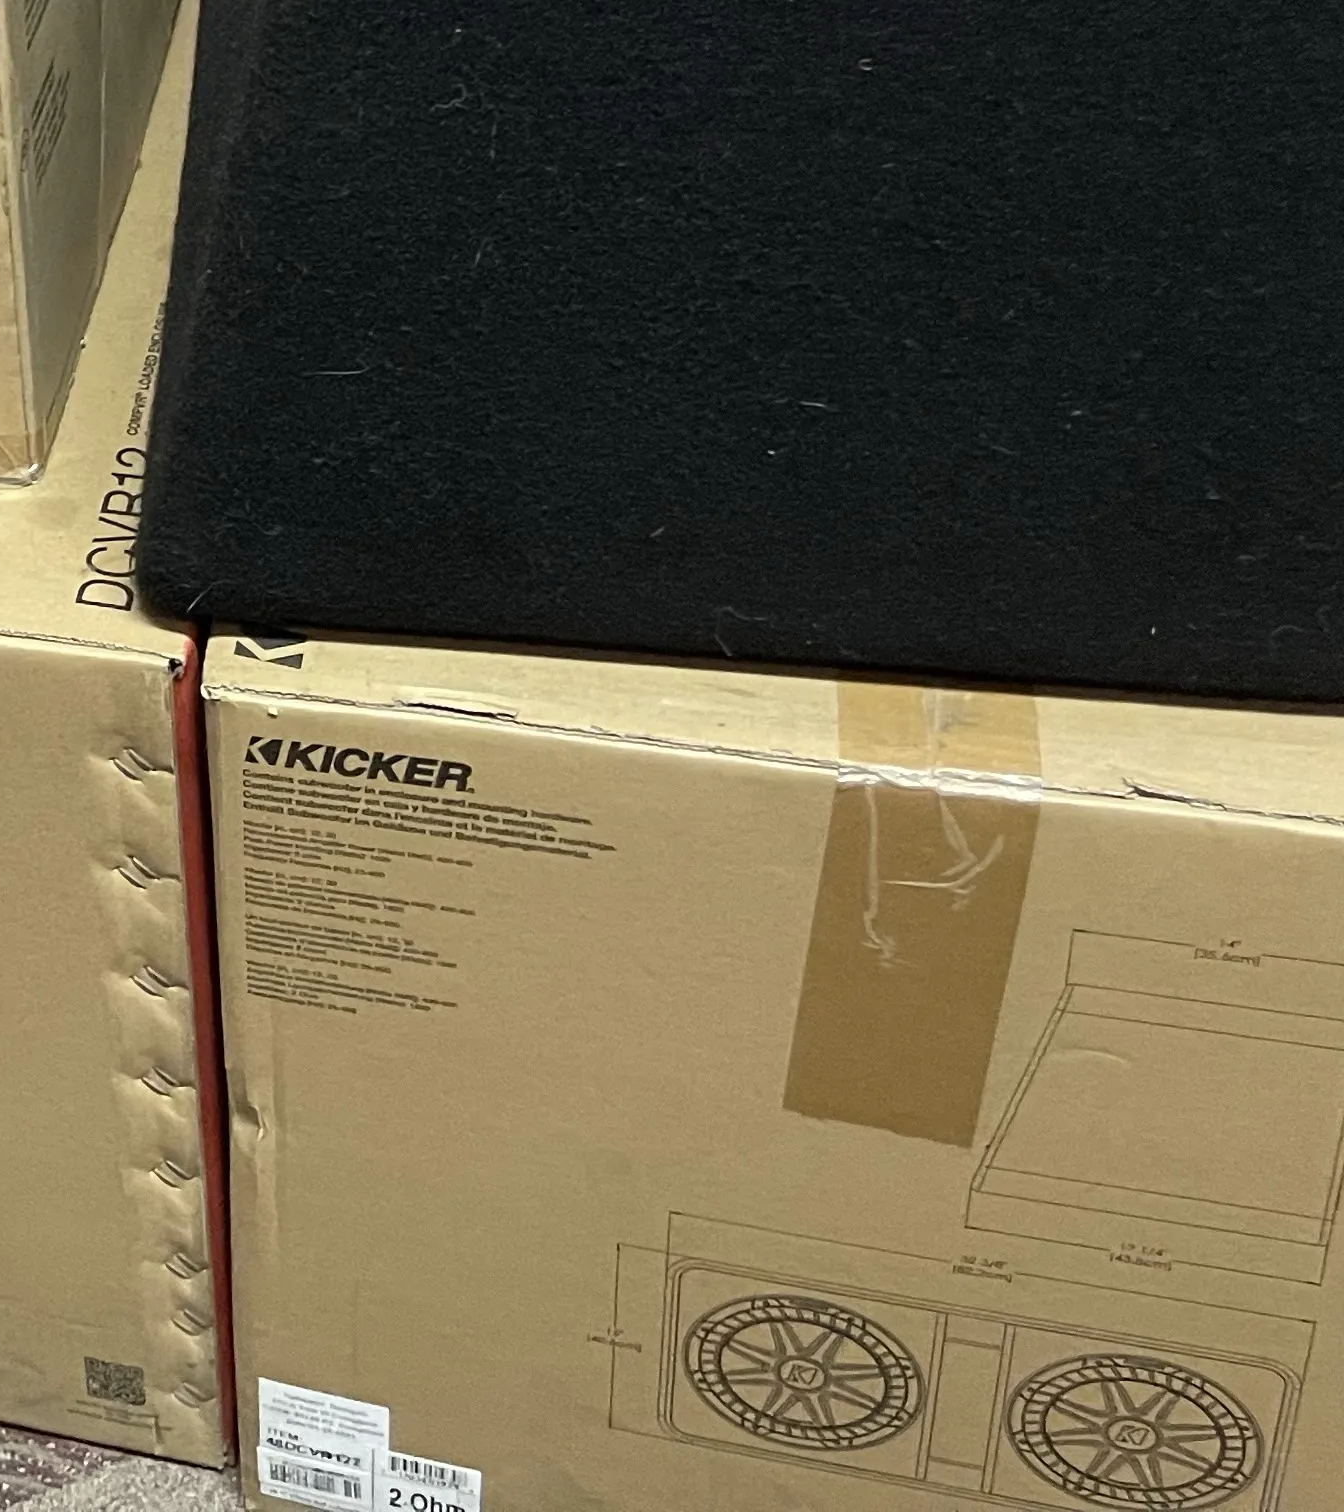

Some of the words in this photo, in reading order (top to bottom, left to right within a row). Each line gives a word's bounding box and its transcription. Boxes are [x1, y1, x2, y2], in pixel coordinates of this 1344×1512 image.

[285, 740, 472, 792] KICKER
[389, 1487, 403, 1508] 2
[411, 1493, 465, 1512] Ohm
